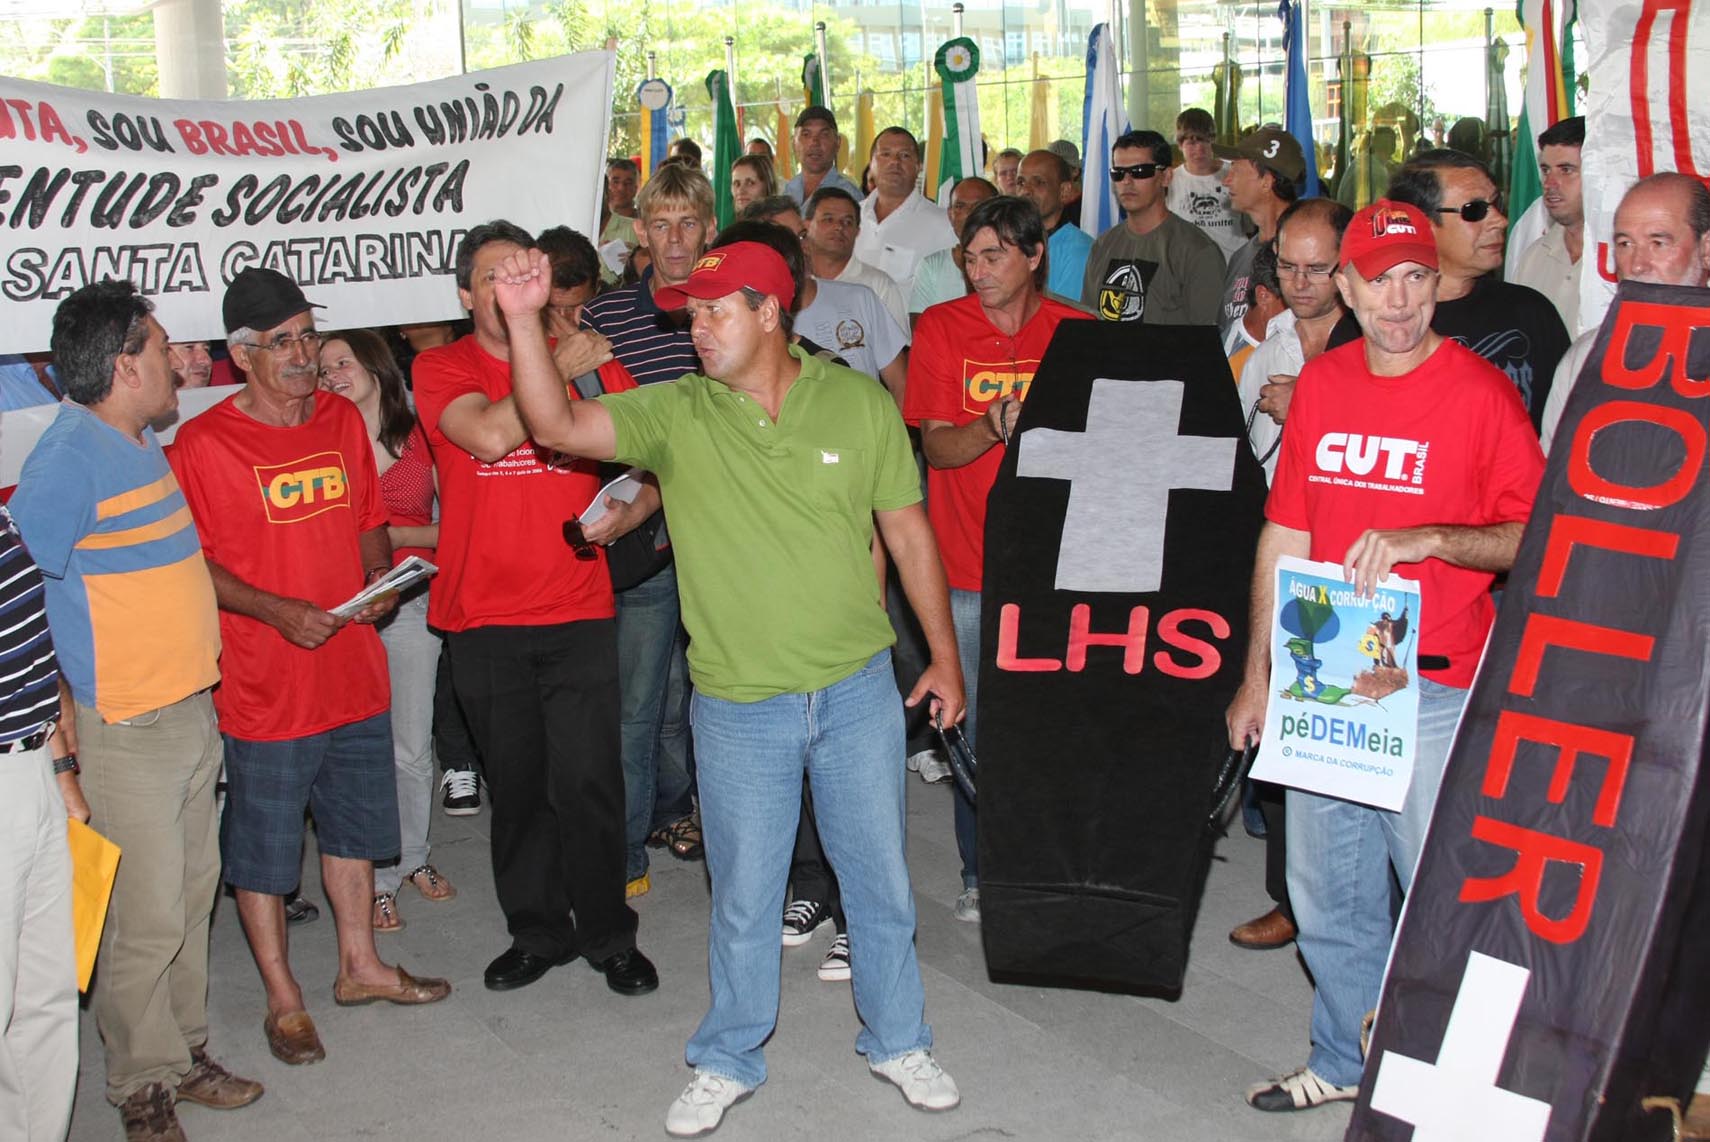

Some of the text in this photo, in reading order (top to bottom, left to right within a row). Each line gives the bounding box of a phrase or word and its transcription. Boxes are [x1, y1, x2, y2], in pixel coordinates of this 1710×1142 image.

[86, 109, 175, 153] SOU
[173, 119, 339, 162] BRASIL,
[332, 110, 415, 152] SOU
[517, 82, 564, 136] DA
[1263, 139, 1280, 159] 3
[211, 159, 470, 228] SOCIALISTA
[2, 241, 210, 301] SANTA
[1411, 441, 1430, 485] BRASIL
[269, 465, 346, 509] CTB
[1289, 576, 1317, 602] ÁGUA
[1318, 584, 1328, 606] X
[996, 602, 1231, 680] LHS
[1457, 299, 1710, 945] BOLLER
[1279, 712, 1404, 758] péDEMeia
[1295, 750, 1394, 777] MARCA DA CORRUPÇÃO
